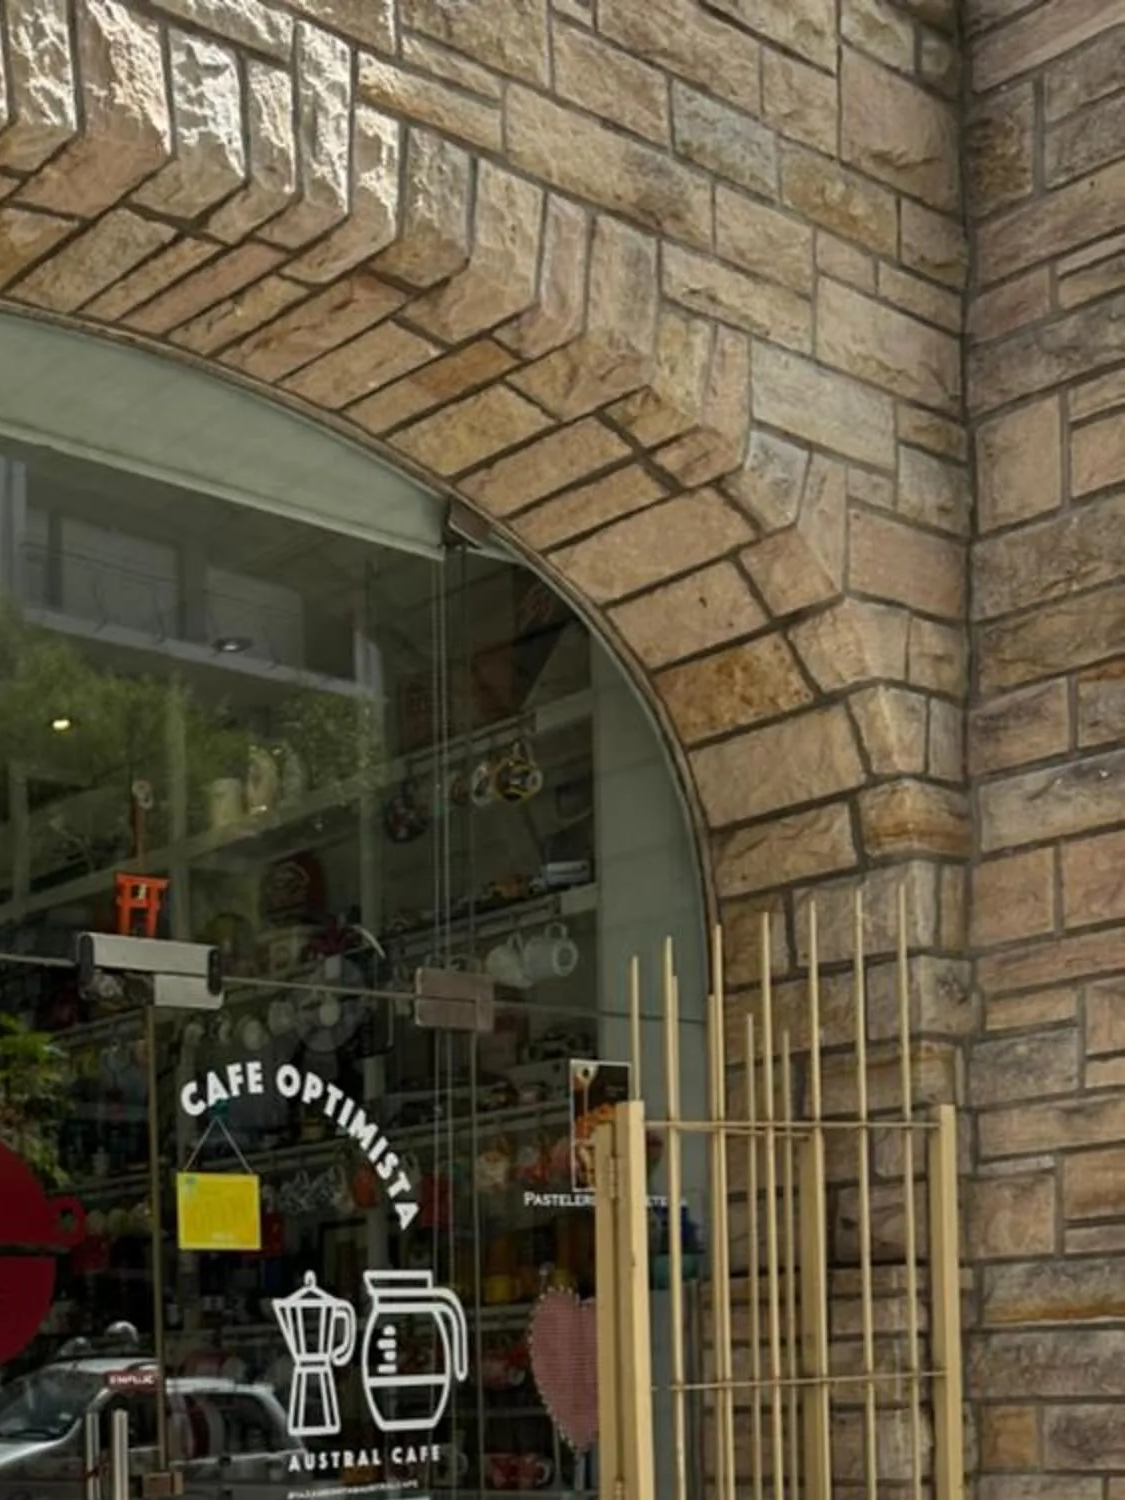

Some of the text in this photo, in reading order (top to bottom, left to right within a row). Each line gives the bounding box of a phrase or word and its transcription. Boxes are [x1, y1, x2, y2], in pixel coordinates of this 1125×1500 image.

[181, 1061, 420, 1231] CAFE OPTIMISTA
[288, 1444, 441, 1472] AUSTRAL CAFE
